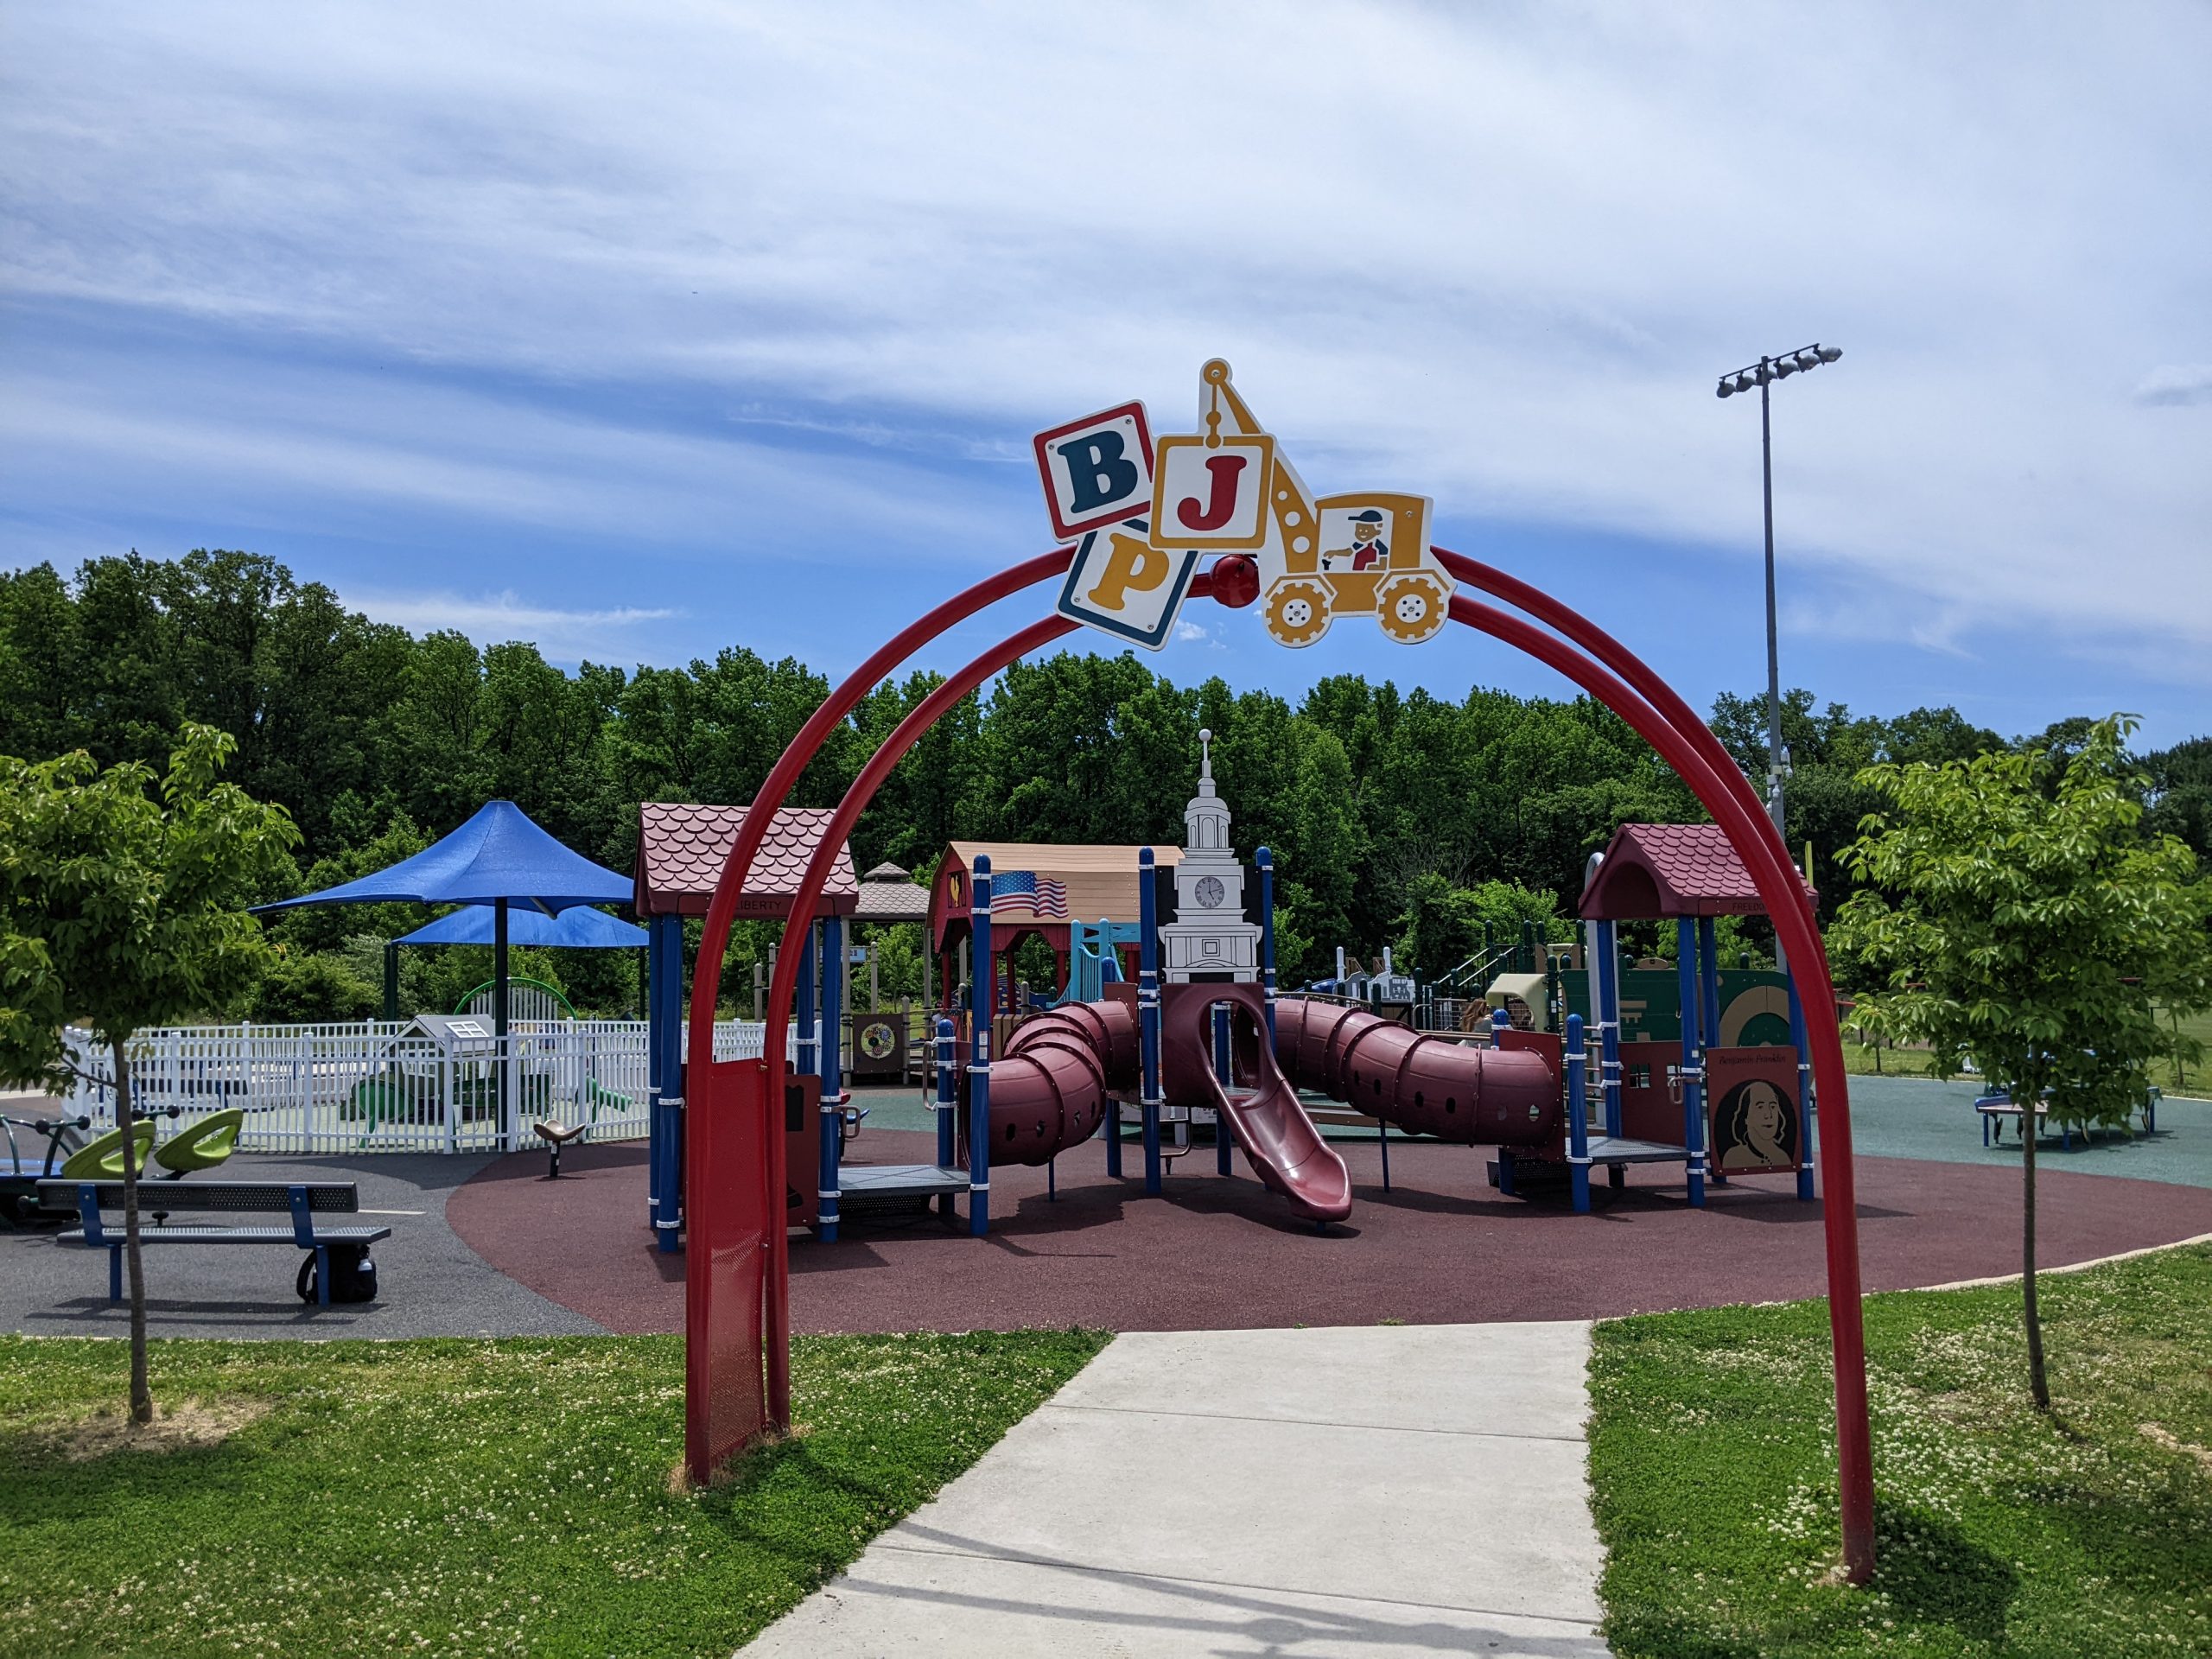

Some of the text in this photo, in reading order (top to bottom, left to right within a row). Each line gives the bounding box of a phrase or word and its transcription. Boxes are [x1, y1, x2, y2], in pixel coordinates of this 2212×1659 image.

[1058, 430, 1138, 514] B
[1177, 456, 1247, 531] J
[1088, 533, 1169, 610] P
[1732, 902, 1764, 911] FREEDO
